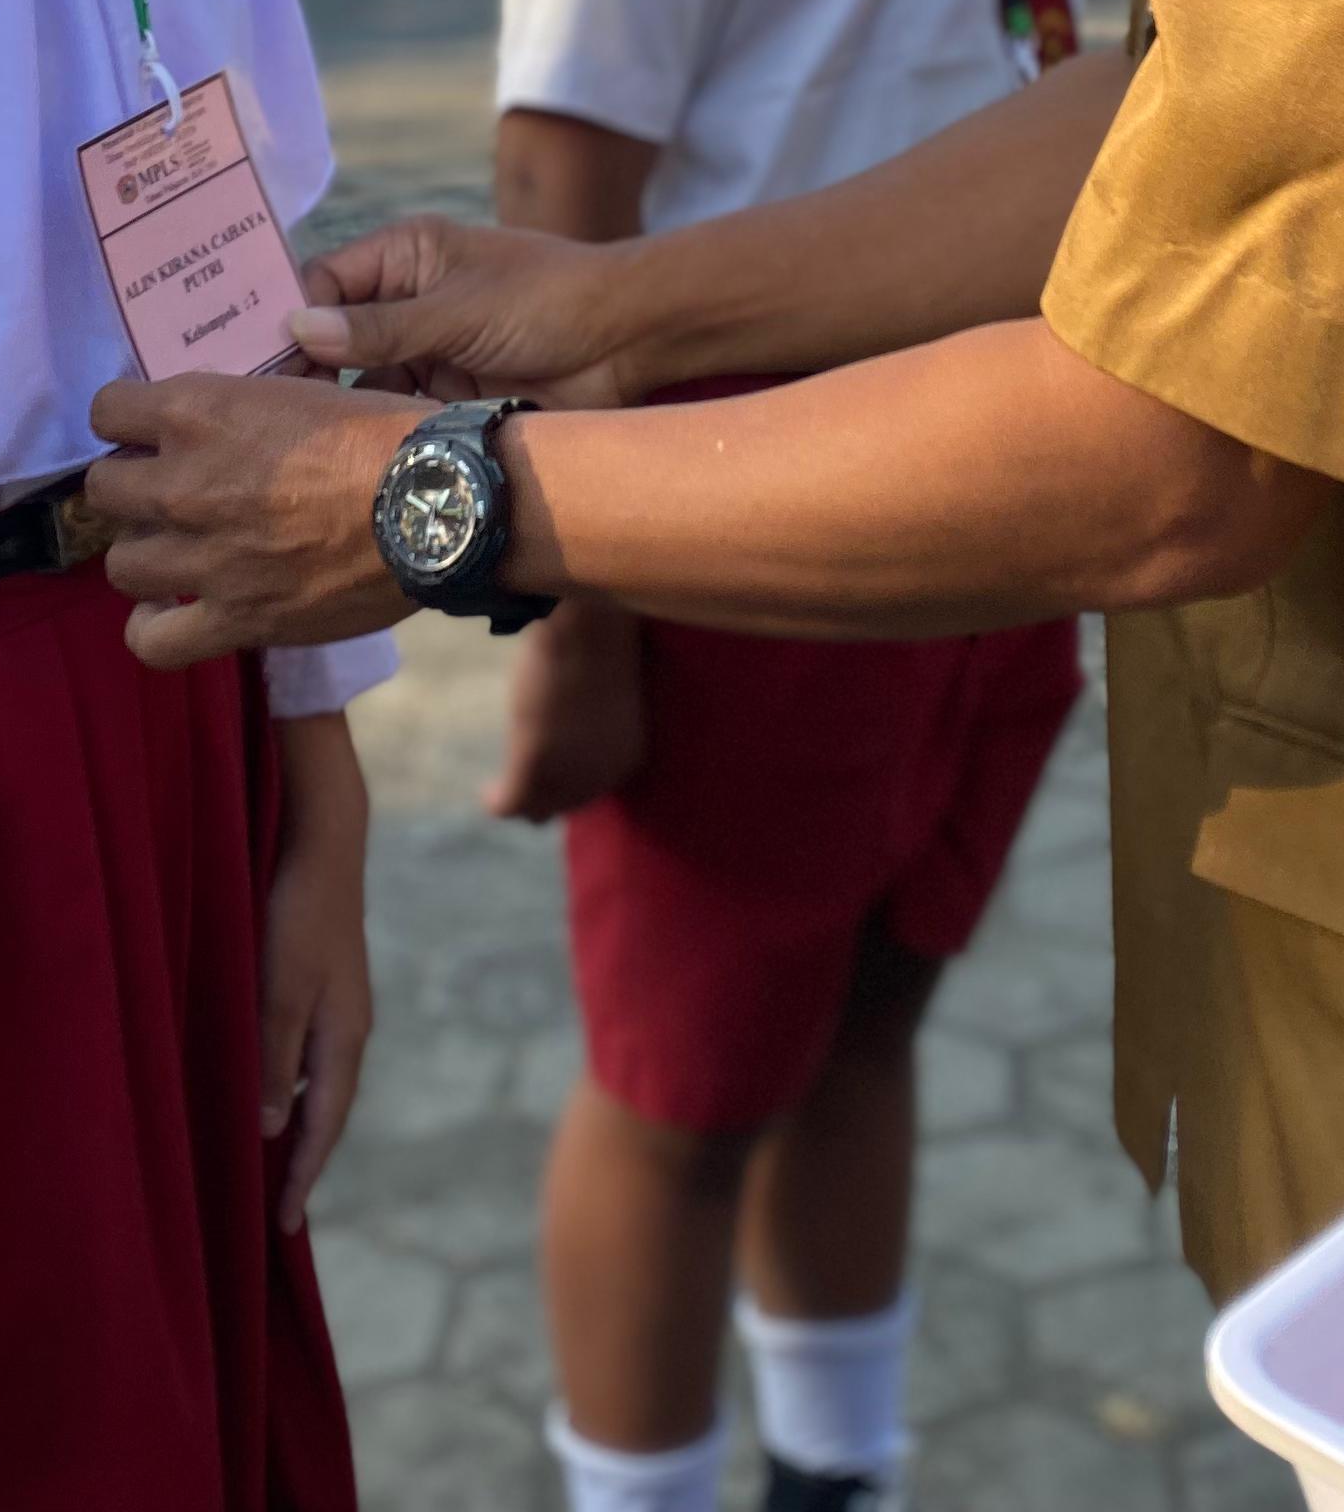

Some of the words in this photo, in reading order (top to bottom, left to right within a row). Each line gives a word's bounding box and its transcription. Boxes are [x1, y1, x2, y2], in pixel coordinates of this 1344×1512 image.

[137, 154, 181, 189] MPLS
[157, 243, 211, 283] KIRANA
[210, 211, 267, 250] CAHAYA
[182, 258, 225, 294] PUTRI
